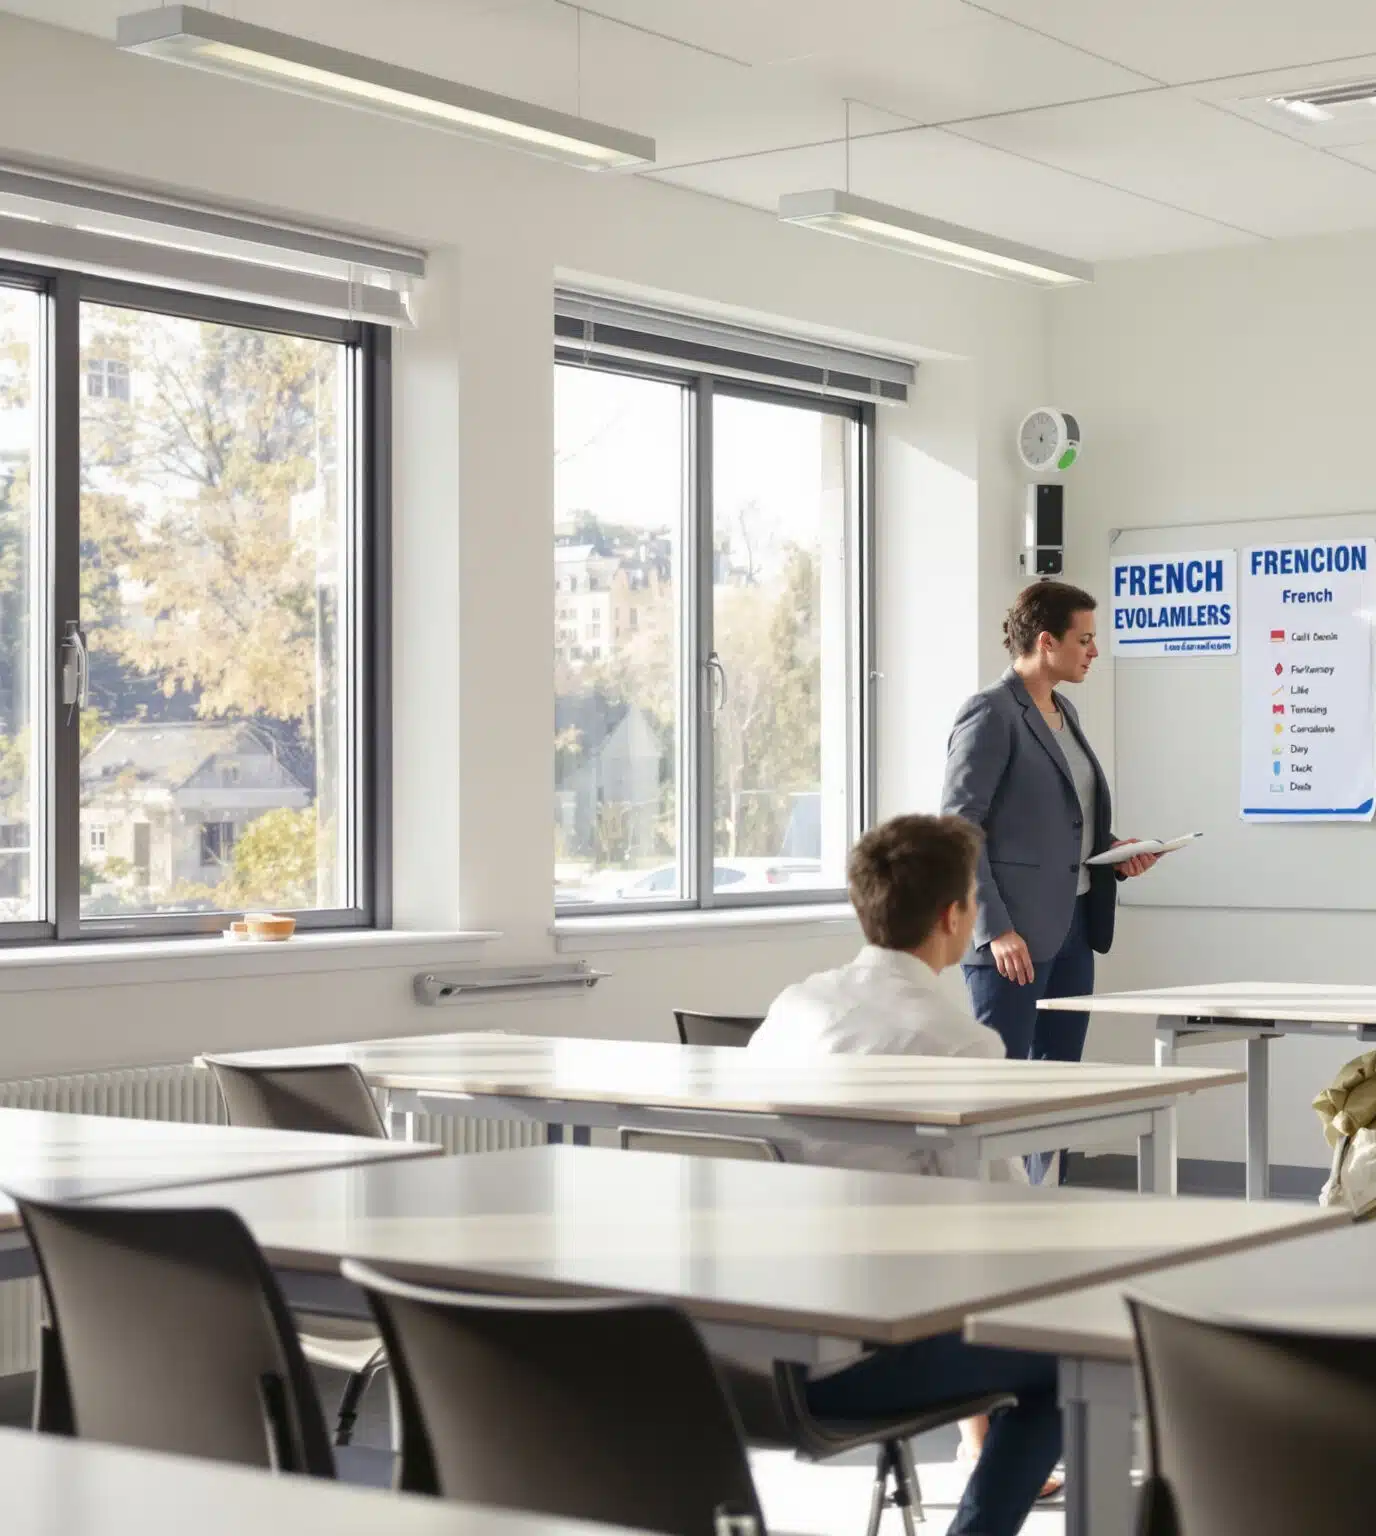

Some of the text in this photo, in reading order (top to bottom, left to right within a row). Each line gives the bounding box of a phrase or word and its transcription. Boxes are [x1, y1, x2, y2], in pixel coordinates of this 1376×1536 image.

[1251, 545, 1367, 575] FRENCION
[1115, 560, 1223, 596] FRENCH
[1282, 588, 1333, 603] French
[1115, 604, 1231, 629] EVOLAMLERS
